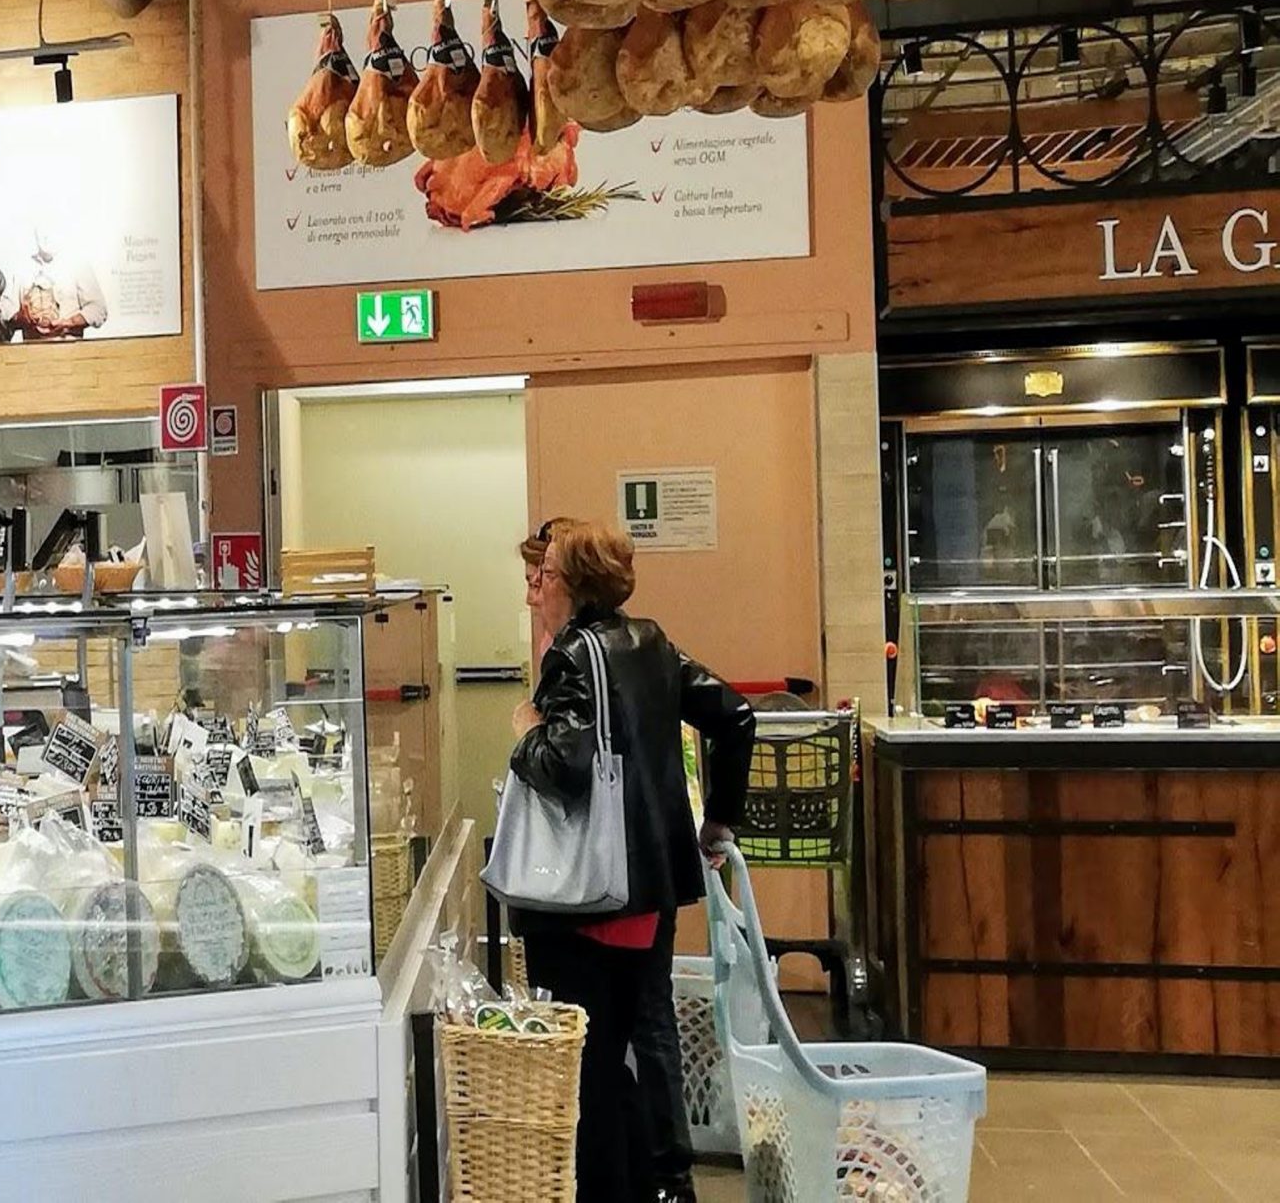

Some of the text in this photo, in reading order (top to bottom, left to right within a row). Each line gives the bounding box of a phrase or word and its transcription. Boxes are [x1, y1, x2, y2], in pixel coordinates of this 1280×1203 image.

[673, 137, 736, 150] Alimentazione
[674, 151, 726, 166] senza OGM
[320, 183, 342, 193] terra
[674, 186, 734, 202] Cottura lenta
[307, 208, 405, 228] Lavorato con il 100%
[682, 204, 706, 217] bassa
[708, 202, 762, 218] temperatura
[307, 224, 400, 245] di energia rinnovabile
[1096, 207, 1280, 281] LA G
